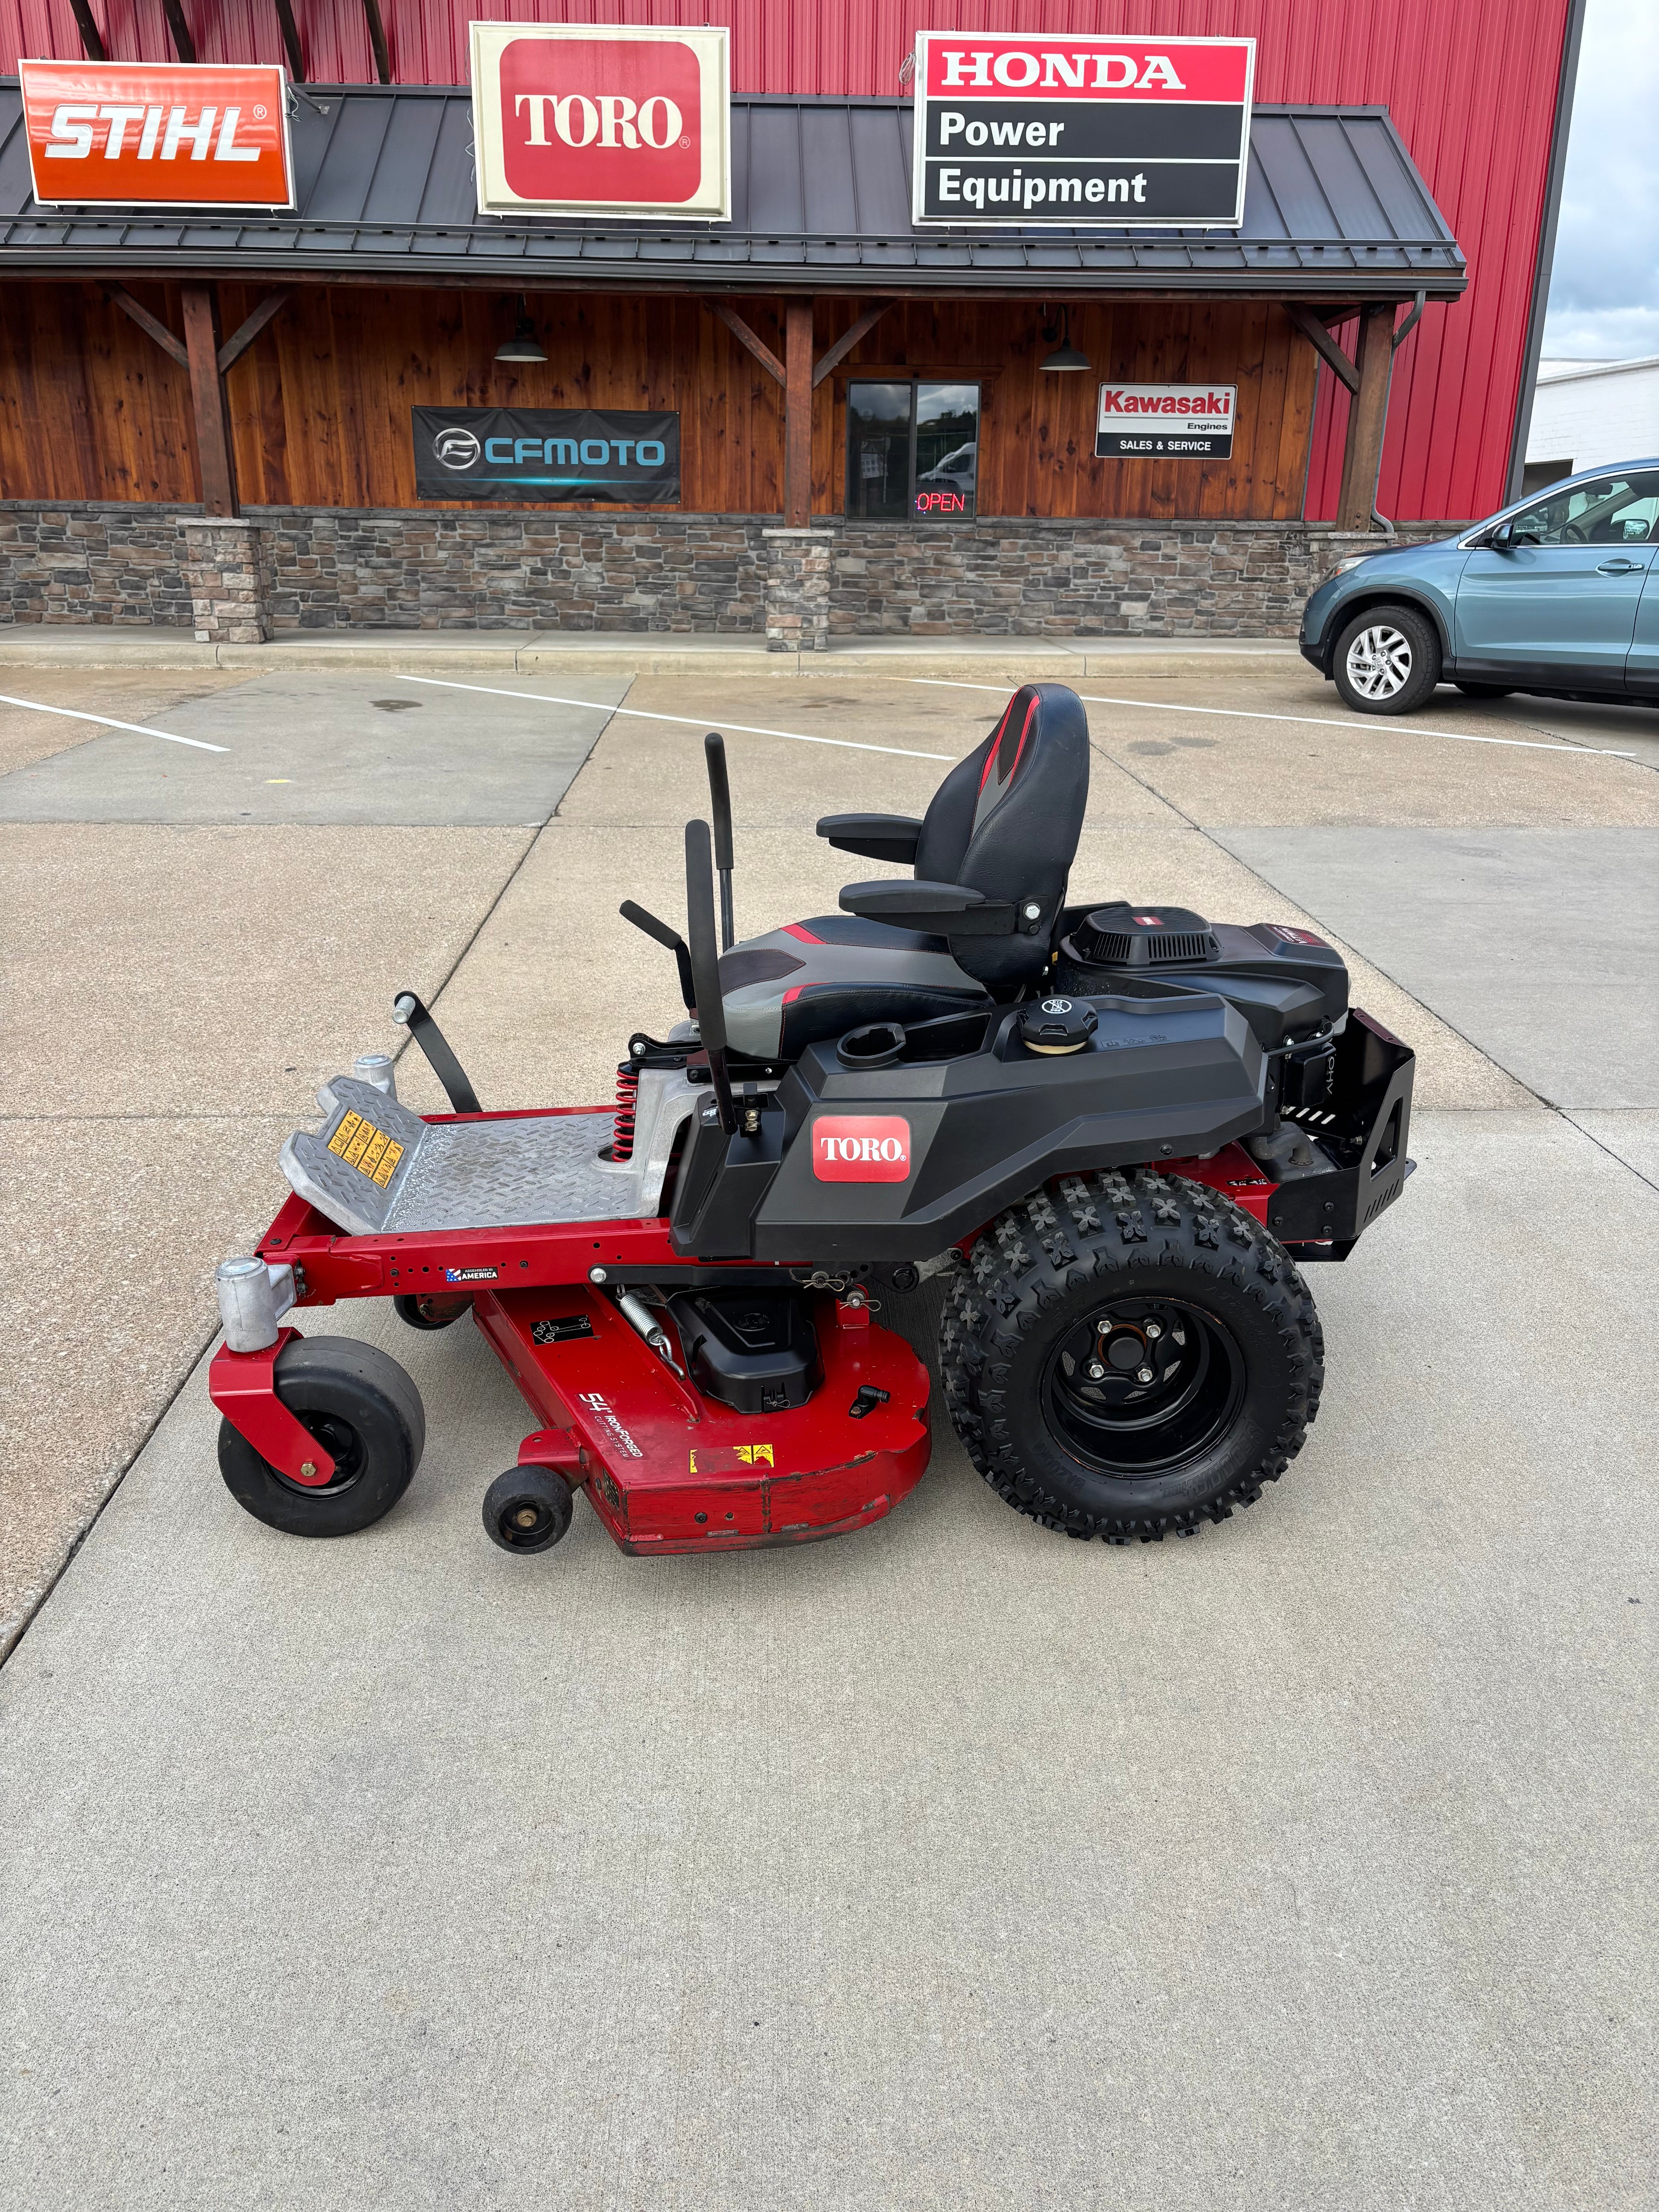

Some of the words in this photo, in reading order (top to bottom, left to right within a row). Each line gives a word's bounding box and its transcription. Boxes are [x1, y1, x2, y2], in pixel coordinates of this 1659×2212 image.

[941, 51, 1186, 90] HONDA
[939, 112, 1065, 147] Power
[938, 168, 1147, 210] Equipment
[1105, 390, 1230, 414] Kawasaki
[1187, 422, 1228, 431] Engines
[485, 437, 665, 466] CFMOTO
[1120, 440, 1152, 450] SALES
[1156, 441, 1164, 450] &
[1168, 441, 1212, 451] SERVICE
[917, 493, 965, 512] OPEN
[1326, 1056, 1334, 1095] OHV
[821, 1137, 902, 1161] TORO
[594, 1416, 614, 1436] CUTTING
[610, 1437, 630, 1458] SYSTEM
[604, 1415, 643, 1457] IRONFORGED
